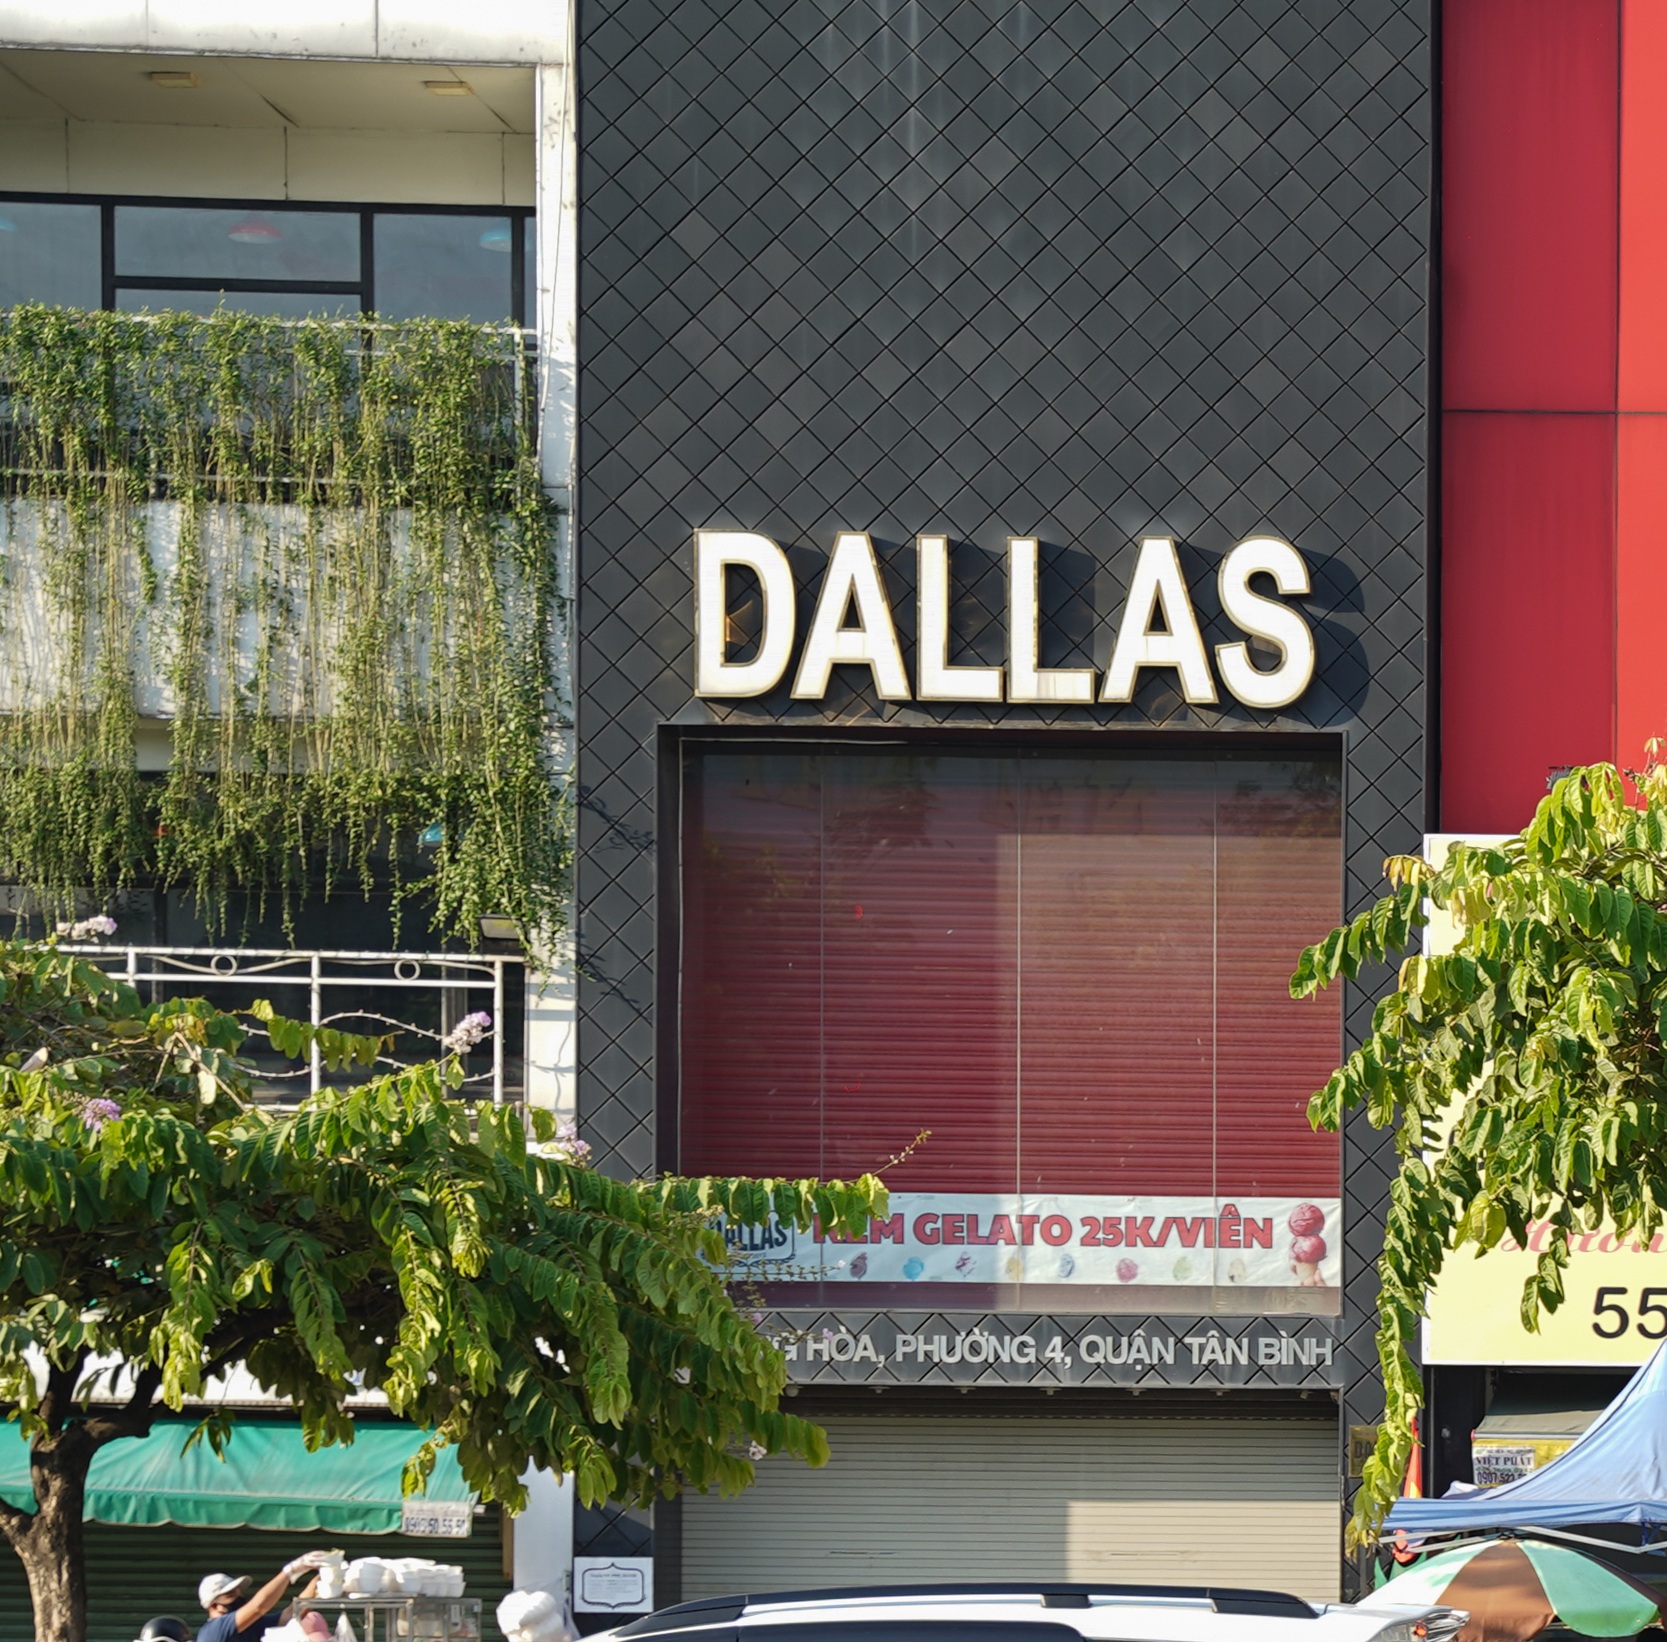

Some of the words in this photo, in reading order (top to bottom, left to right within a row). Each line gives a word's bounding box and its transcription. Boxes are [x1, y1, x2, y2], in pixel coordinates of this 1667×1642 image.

[693, 528, 1316, 710] DALLAS
[913, 1212, 1073, 1247] GELATO
[1080, 1203, 1273, 1250] 25K/VIÊN
[806, 1325, 885, 1368] HÒA,
[895, 1327, 1037, 1364] PHƯỜNG
[1045, 1335, 1072, 1370] 4,
[1079, 1328, 1175, 1371] QUẬN
[1185, 1330, 1249, 1366] TÂN
[1258, 1330, 1333, 1366] BÌNH
